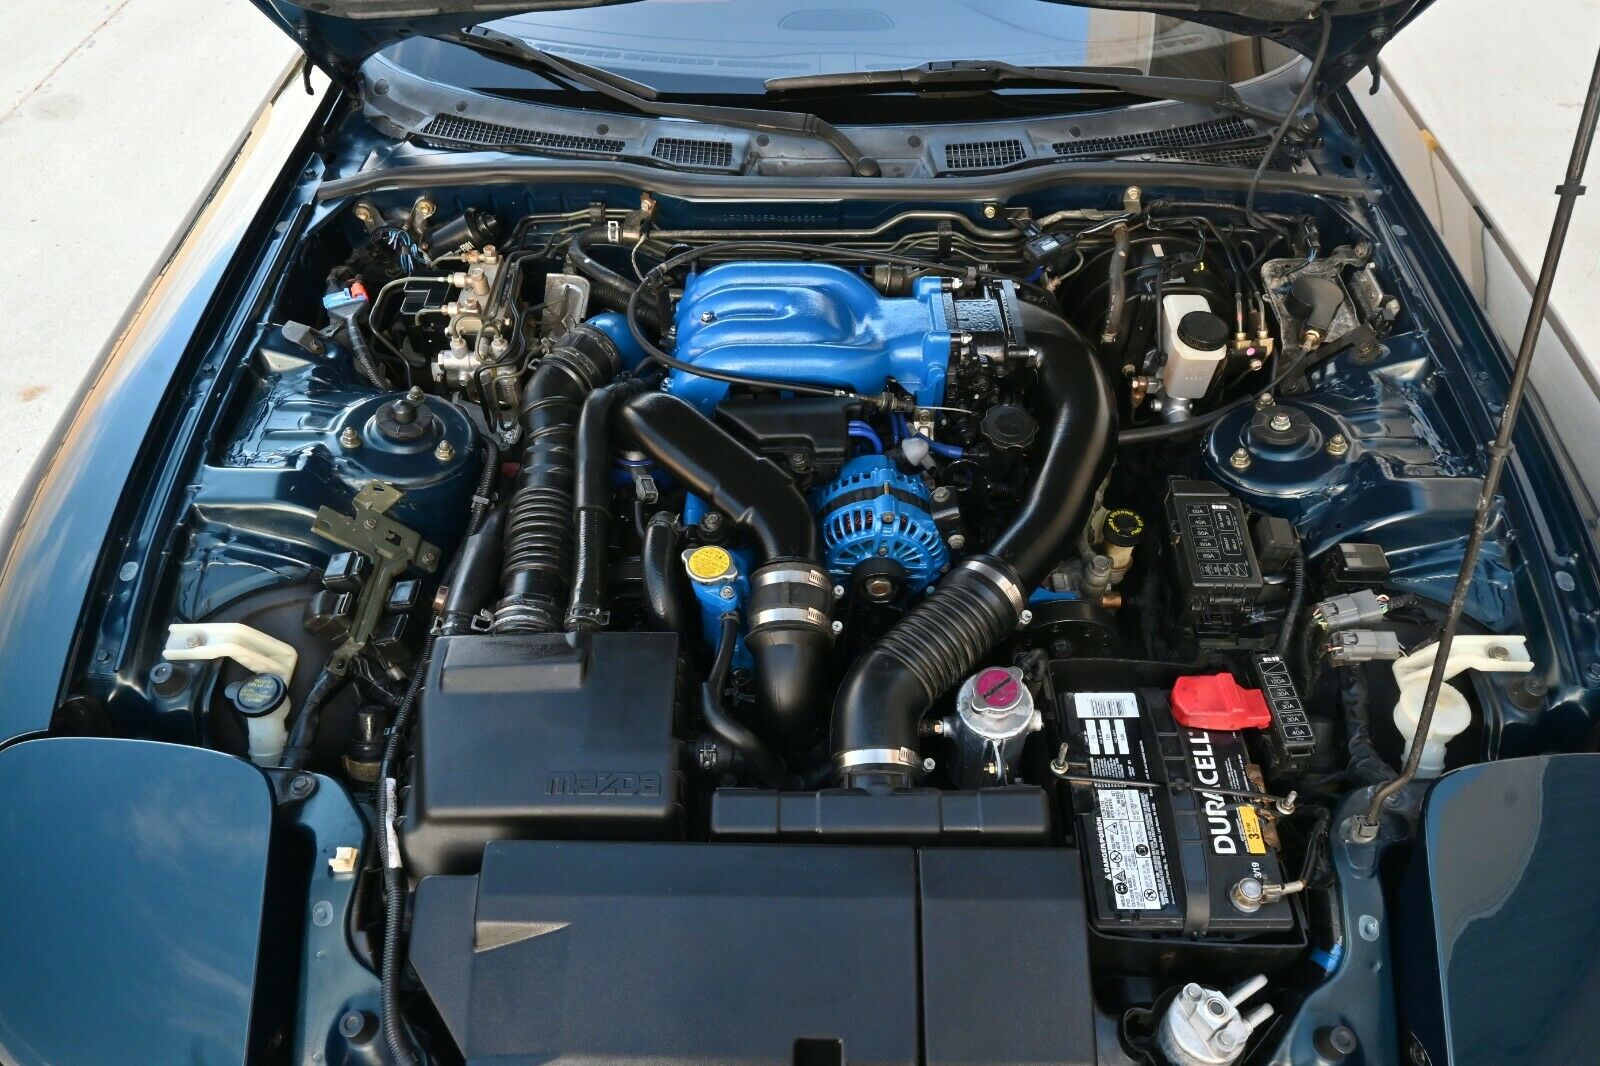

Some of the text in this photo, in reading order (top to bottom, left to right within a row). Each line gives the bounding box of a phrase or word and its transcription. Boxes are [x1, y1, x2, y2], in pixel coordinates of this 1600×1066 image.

[544, 771, 661, 796] mazda
[1189, 732, 1237, 854] DURACELL
[1251, 862, 1263, 879] 3/19
